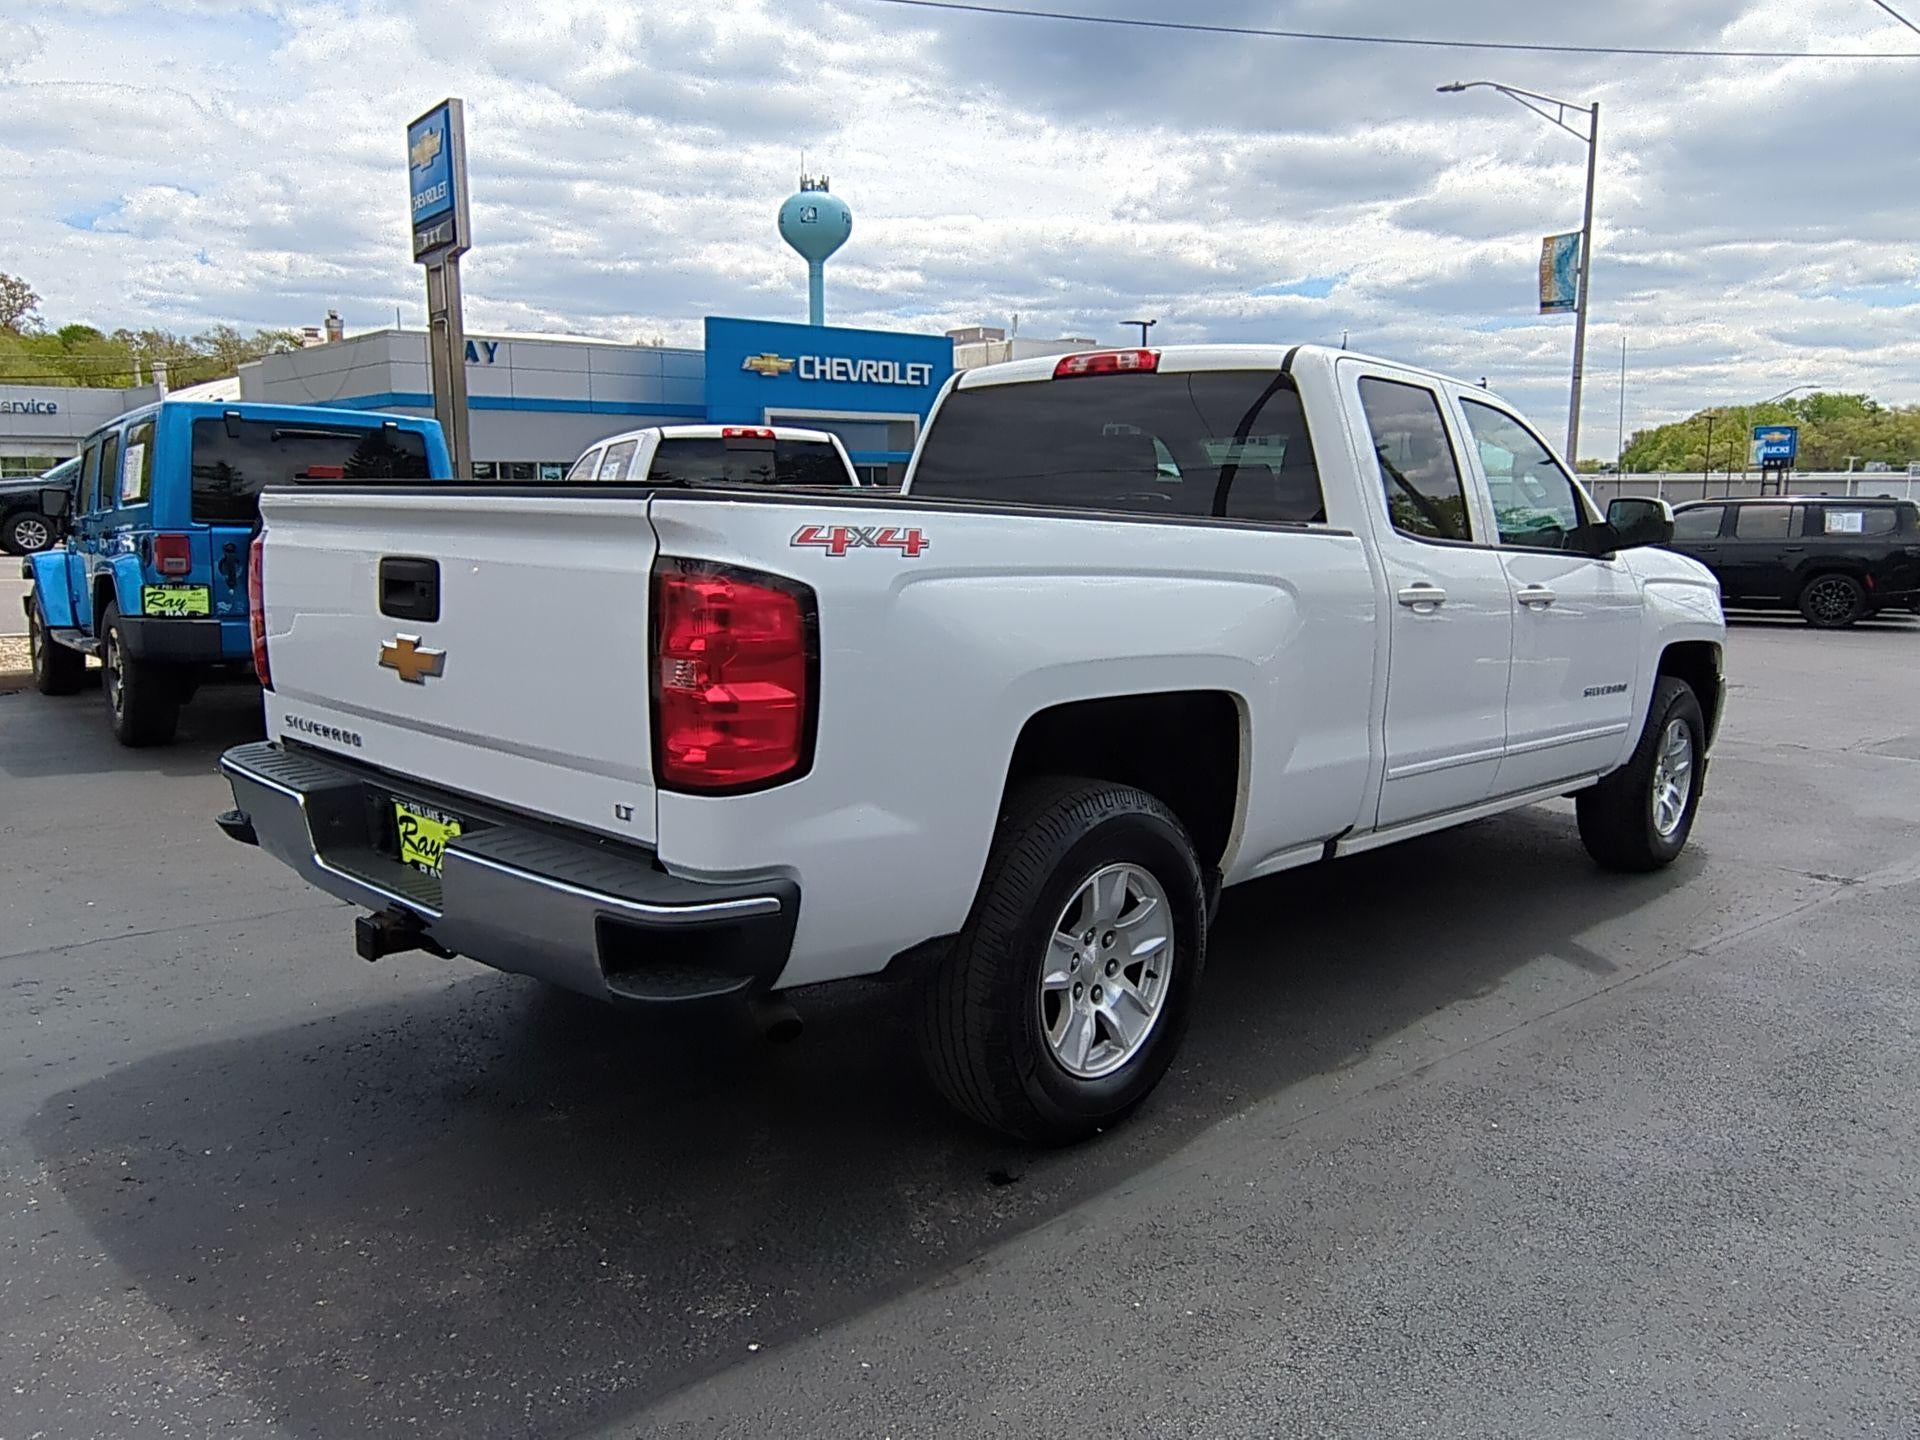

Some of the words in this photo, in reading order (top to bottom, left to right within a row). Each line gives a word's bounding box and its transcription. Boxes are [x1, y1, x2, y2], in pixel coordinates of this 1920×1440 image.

[412, 181, 447, 211] CHEVROLET
[465, 340, 498, 363] AY
[799, 356, 933, 386] CHEVROLET
[0, 399, 57, 414] ervice
[146, 591, 187, 611] Ray
[285, 714, 362, 747] SILVERADO
[615, 804, 635, 822] LT
[399, 815, 443, 869] Ray
